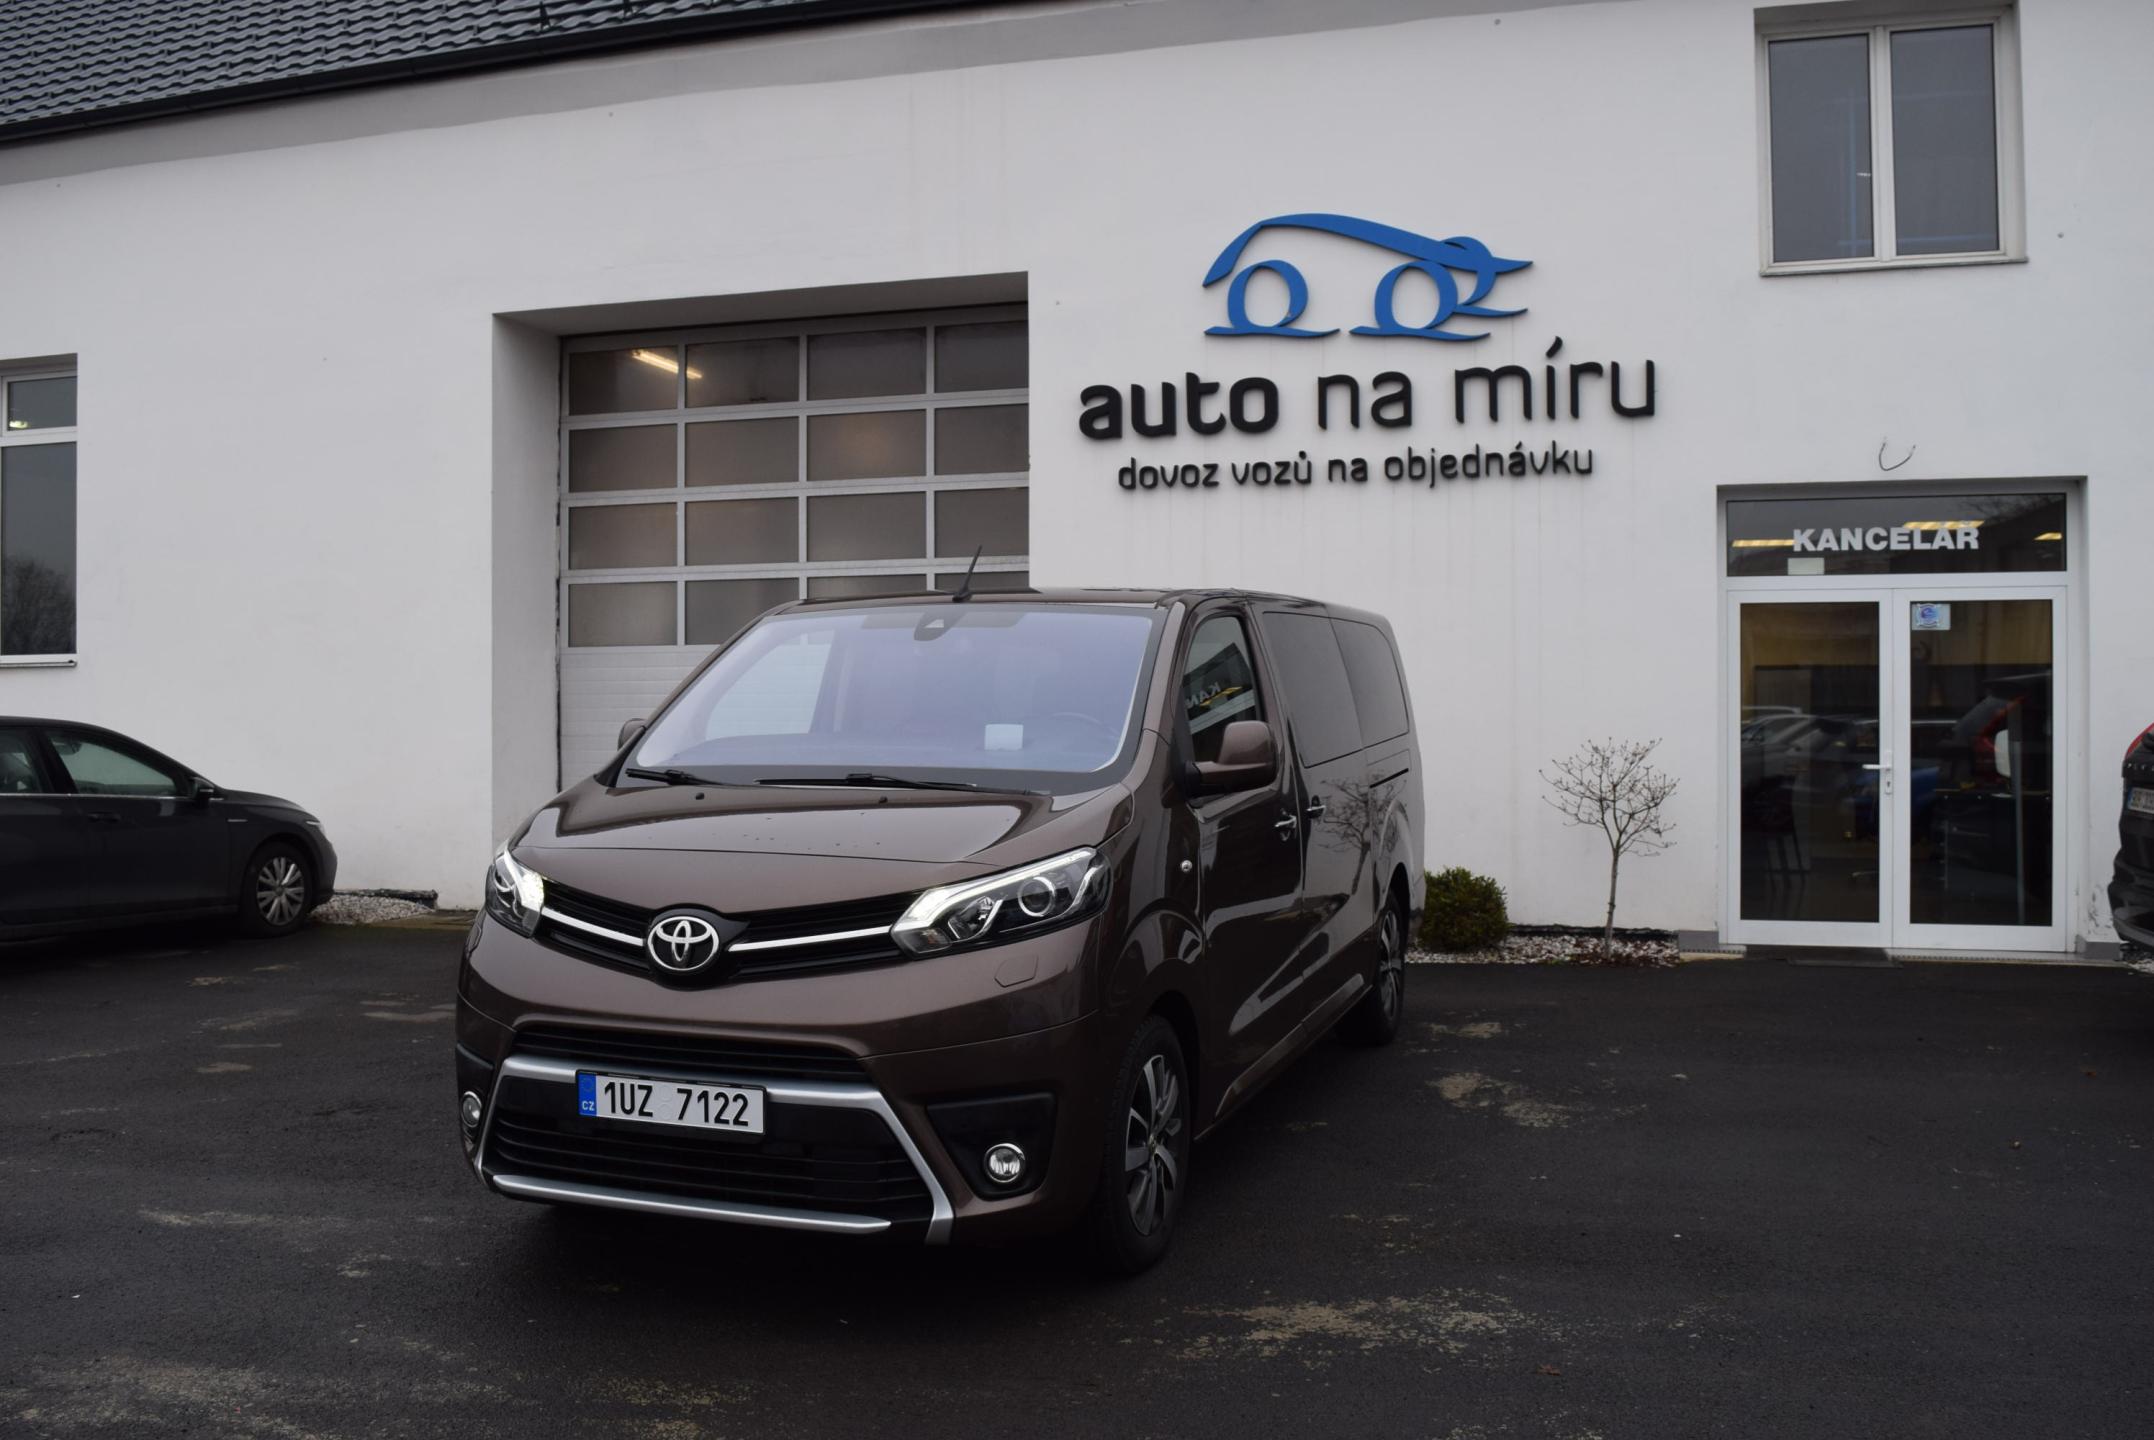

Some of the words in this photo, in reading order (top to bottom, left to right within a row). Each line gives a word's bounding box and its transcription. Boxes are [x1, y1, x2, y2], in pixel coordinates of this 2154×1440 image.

[1079, 372, 1280, 441] auto
[1317, 371, 1413, 430] na
[1454, 336, 1656, 424] míru
[1118, 457, 1220, 491] dovoz
[1231, 450, 1313, 487] vozů
[1327, 457, 1369, 484] na
[1384, 440, 1594, 489] objednávku
[581, 1100, 595, 1111] CZ
[604, 1081, 654, 1118] 1UZ
[676, 1087, 749, 1127] 7122
